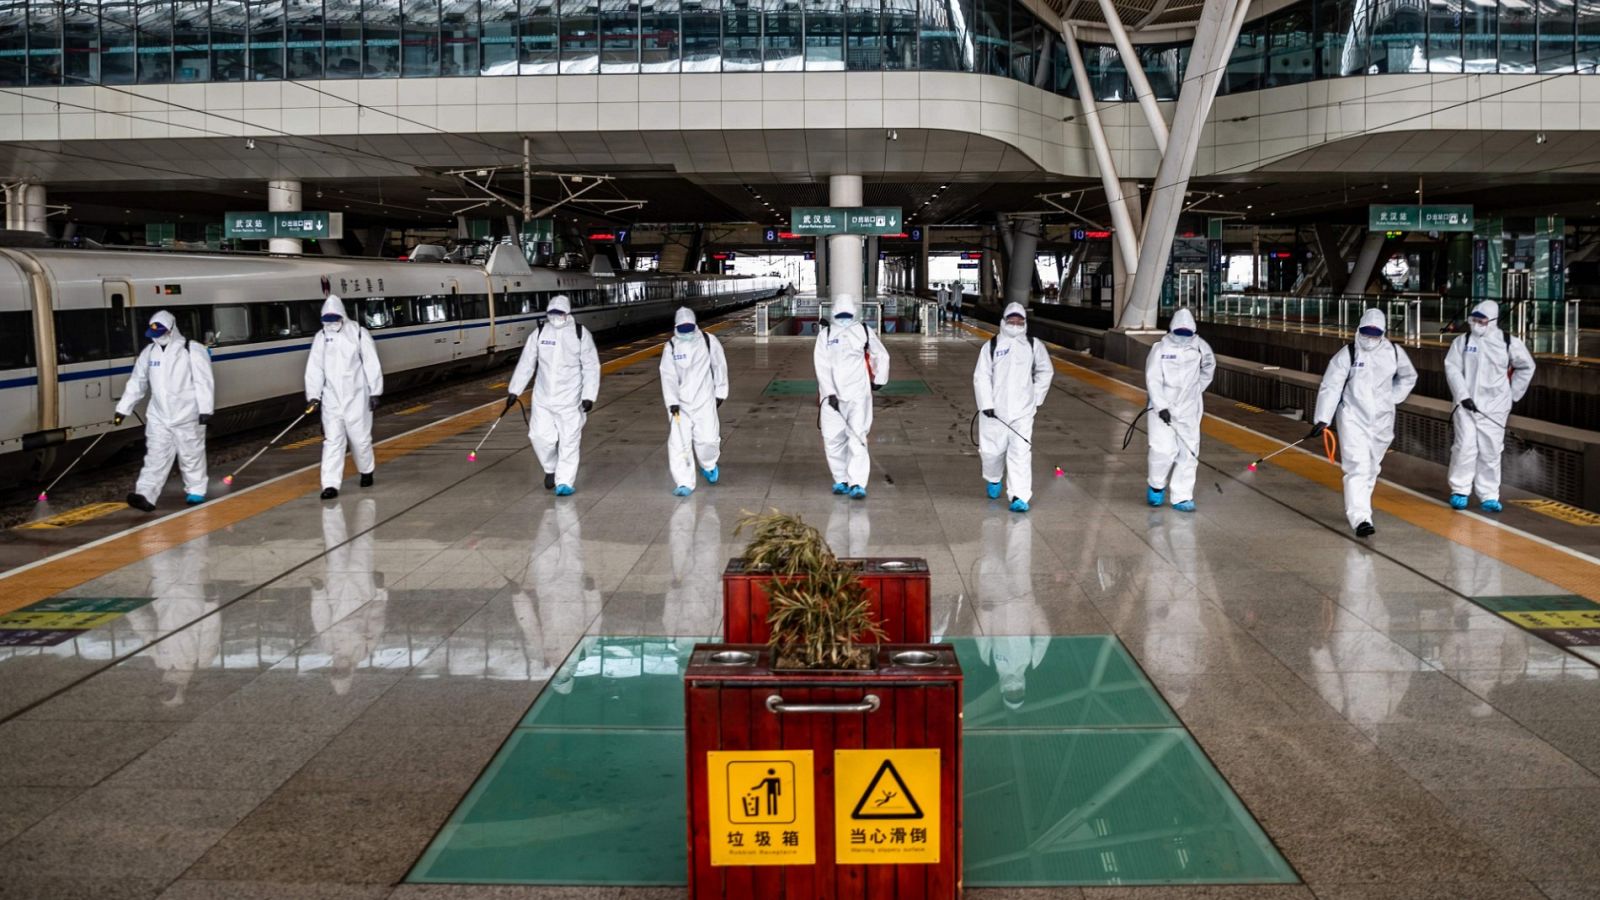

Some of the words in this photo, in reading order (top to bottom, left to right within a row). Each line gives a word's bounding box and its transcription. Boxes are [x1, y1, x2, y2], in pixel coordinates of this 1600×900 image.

[803, 215, 832, 224] 武汉站
[1380, 212, 1408, 221] 武汉站
[235, 219, 263, 228] 武汉站
[619, 231, 626, 241] 7
[767, 231, 774, 240] 8
[913, 231, 920, 240] 9
[1074, 229, 1084, 240] 10
[727, 830, 799, 847] 垃圾箱
[850, 827, 927, 844] 当心滑倒
